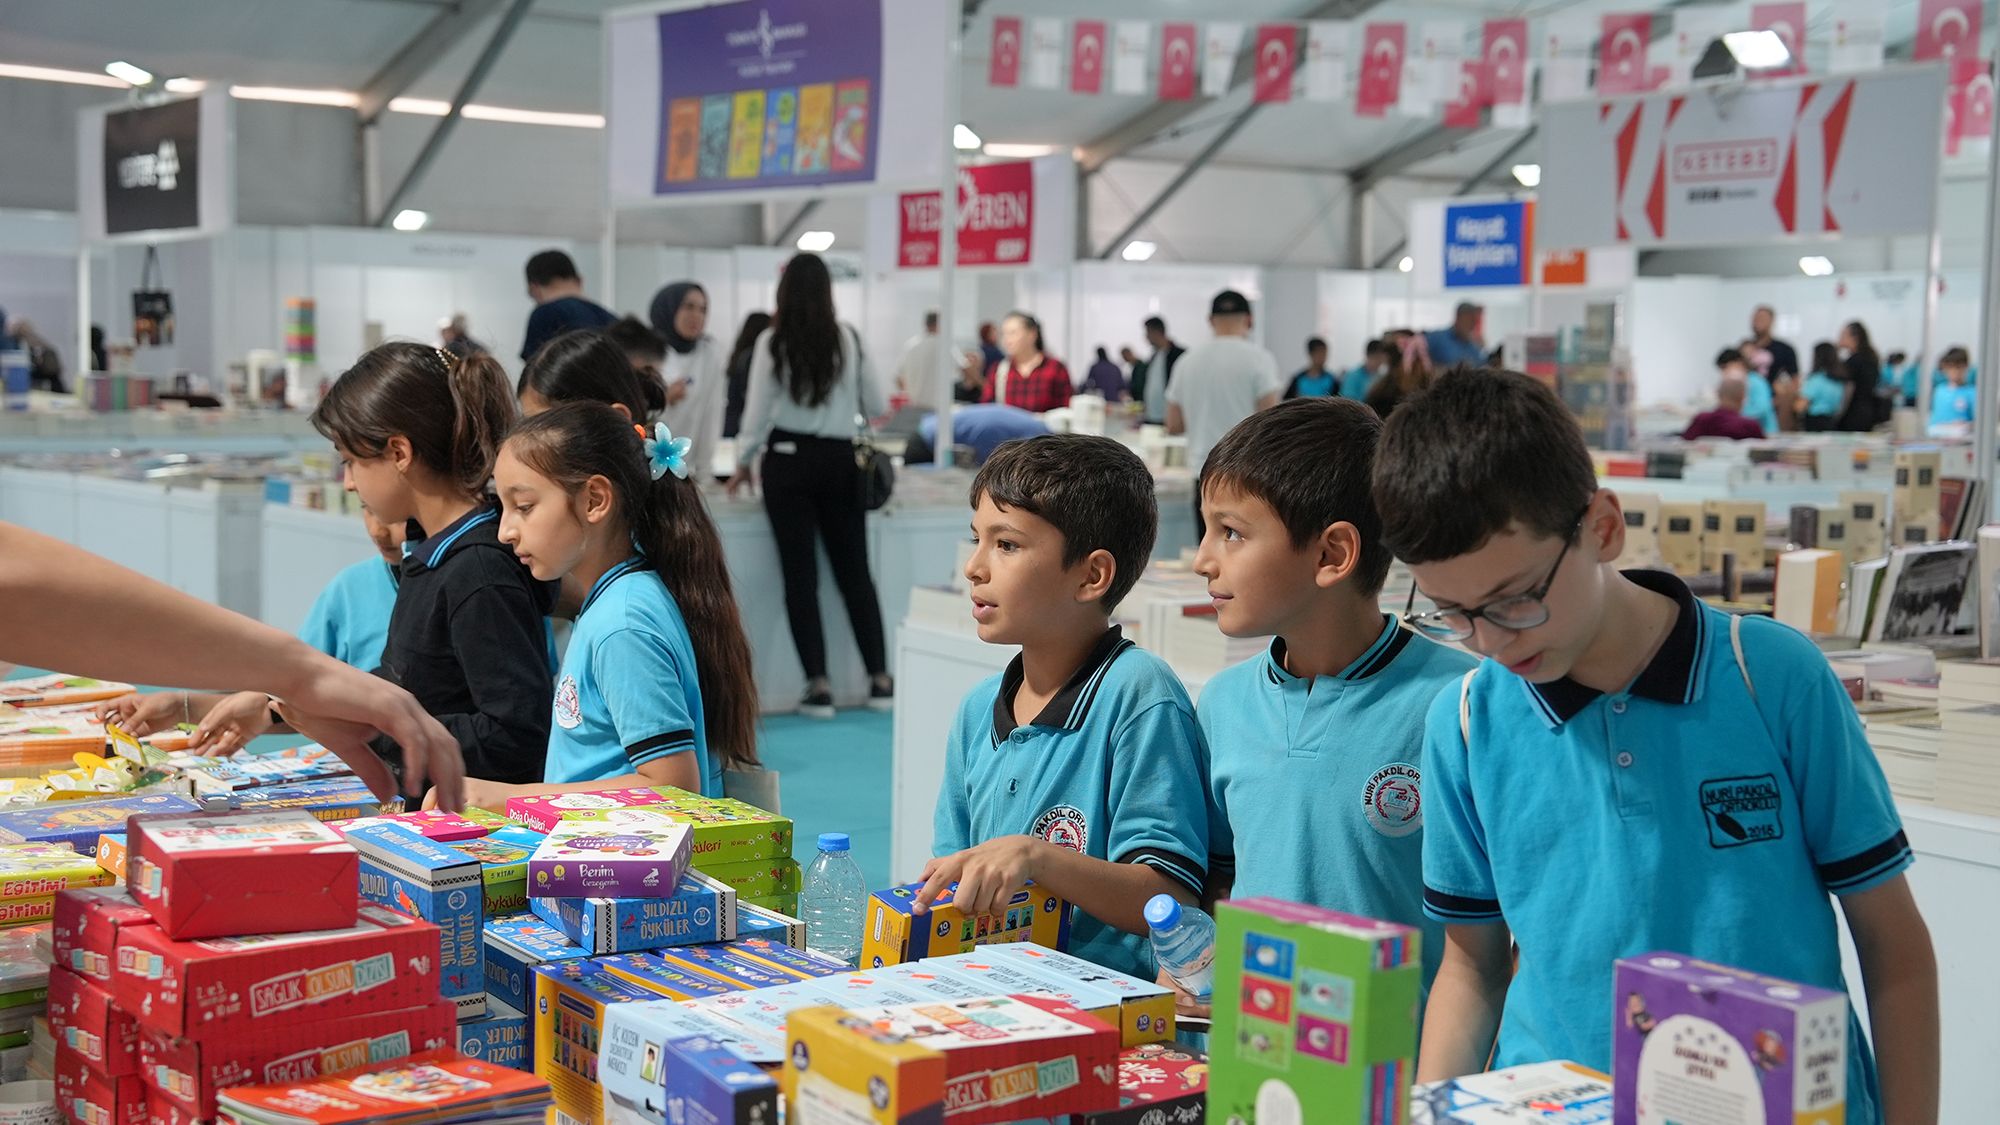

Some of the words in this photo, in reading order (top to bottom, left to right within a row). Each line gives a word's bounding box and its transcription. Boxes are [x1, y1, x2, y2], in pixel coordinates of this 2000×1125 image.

[903, 190, 1028, 232] YEDVEREN
[1373, 766, 1405, 784] PAKDİL
[1035, 808, 1066, 836] PAKDİL
[692, 839, 721, 854] küleri
[579, 863, 615, 878] Benim
[360, 872, 388, 897] YILDIZLI
[642, 900, 688, 920] YILDIZLI
[640, 919, 691, 940] ÖYKÜLER
[939, 921, 949, 930] 10
[440, 917, 455, 967] YILDIZLI
[457, 910, 476, 967] ÖYKÜLER
[256, 978, 304, 1011] SAĞLIK
[309, 968, 353, 996] OLSUN
[355, 953, 393, 988] DİZİSİ
[1139, 1015, 1148, 1024] 10
[271, 1055, 319, 1084] SAĞLIK
[323, 1045, 367, 1075] OLSUN
[487, 1045, 529, 1063] ILDIZLI
[994, 1069, 1036, 1099] OLSUN
